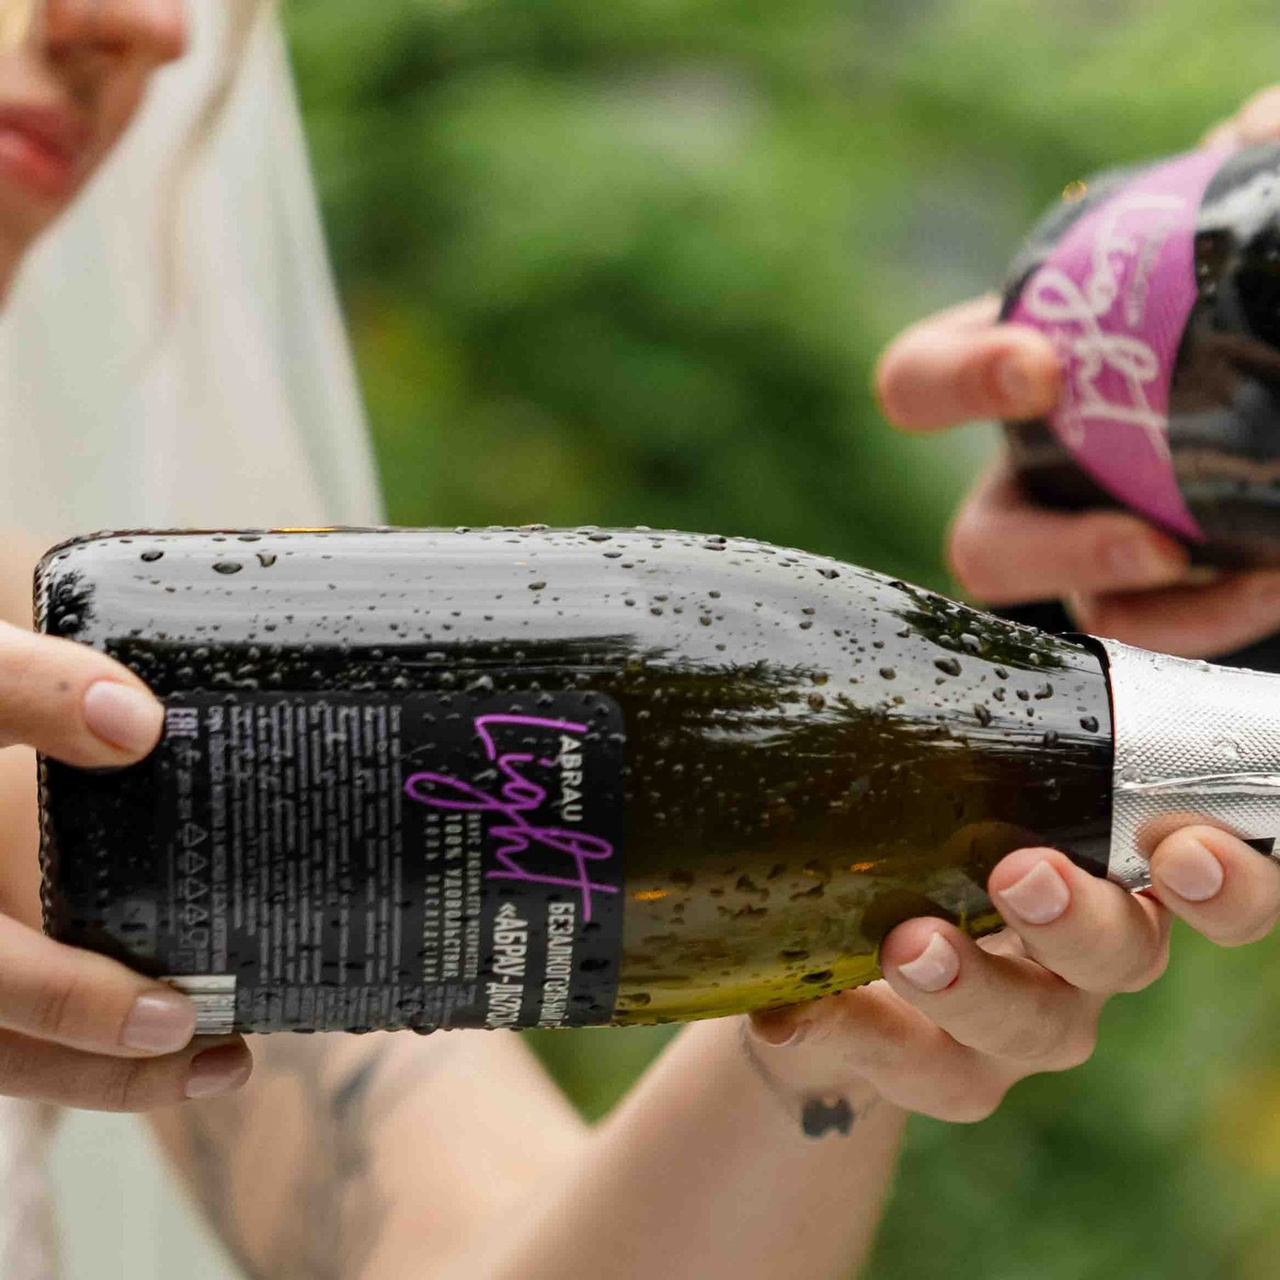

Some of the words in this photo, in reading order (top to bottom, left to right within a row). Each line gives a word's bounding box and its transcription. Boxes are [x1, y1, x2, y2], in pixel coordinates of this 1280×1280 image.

[559, 735, 584, 823] ABRAU
[405, 714, 620, 922] Light
[424, 813, 440, 860] НОЛЬ
[444, 814, 463, 860] 100%
[467, 813, 482, 845] ВКУС
